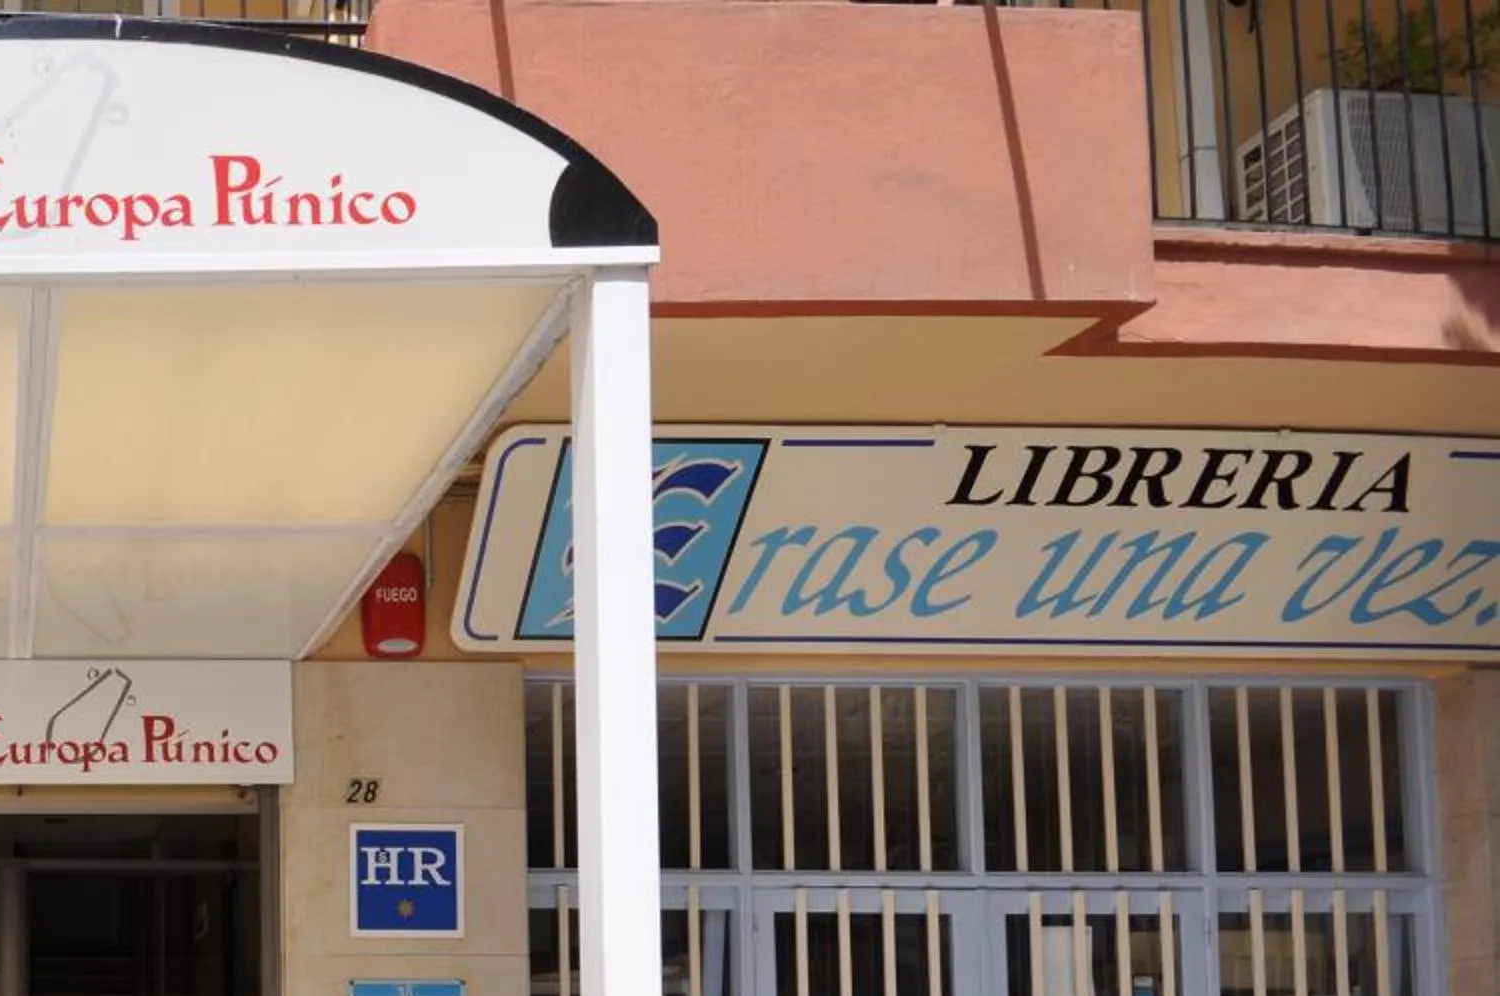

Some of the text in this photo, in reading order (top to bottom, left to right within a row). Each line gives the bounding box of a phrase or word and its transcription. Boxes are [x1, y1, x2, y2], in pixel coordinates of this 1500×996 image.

[207, 154, 417, 227] Púnico
[945, 445, 1411, 513] LIBRERIA
[375, 586, 418, 603] FUEGO
[1014, 527, 1271, 622] una
[141, 715, 279, 765] Púnico
[346, 780, 380, 804] 28
